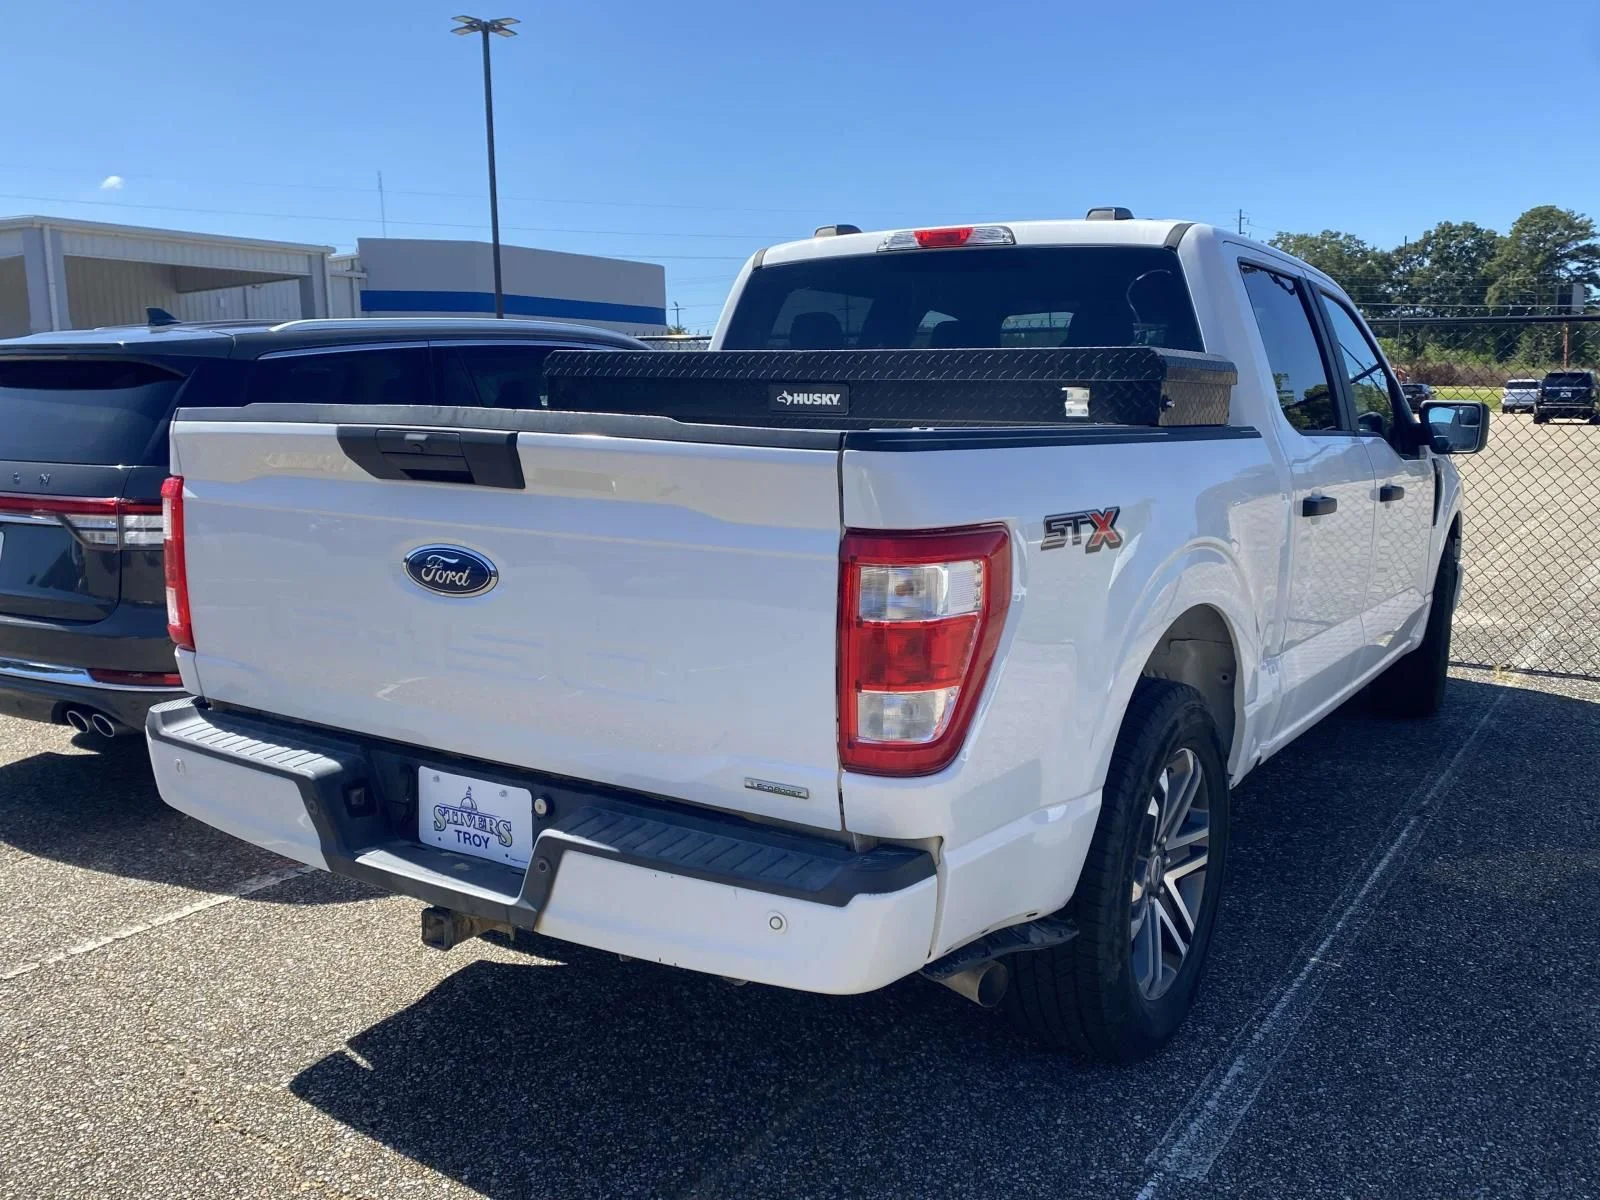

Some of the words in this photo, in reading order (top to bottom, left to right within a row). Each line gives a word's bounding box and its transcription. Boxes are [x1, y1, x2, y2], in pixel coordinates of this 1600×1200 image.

[793, 393, 840, 405] HUSKY
[1041, 506, 1122, 554] STX
[421, 554, 472, 587] Ford
[433, 804, 512, 847] STIVERS
[454, 829, 490, 849] TROY
